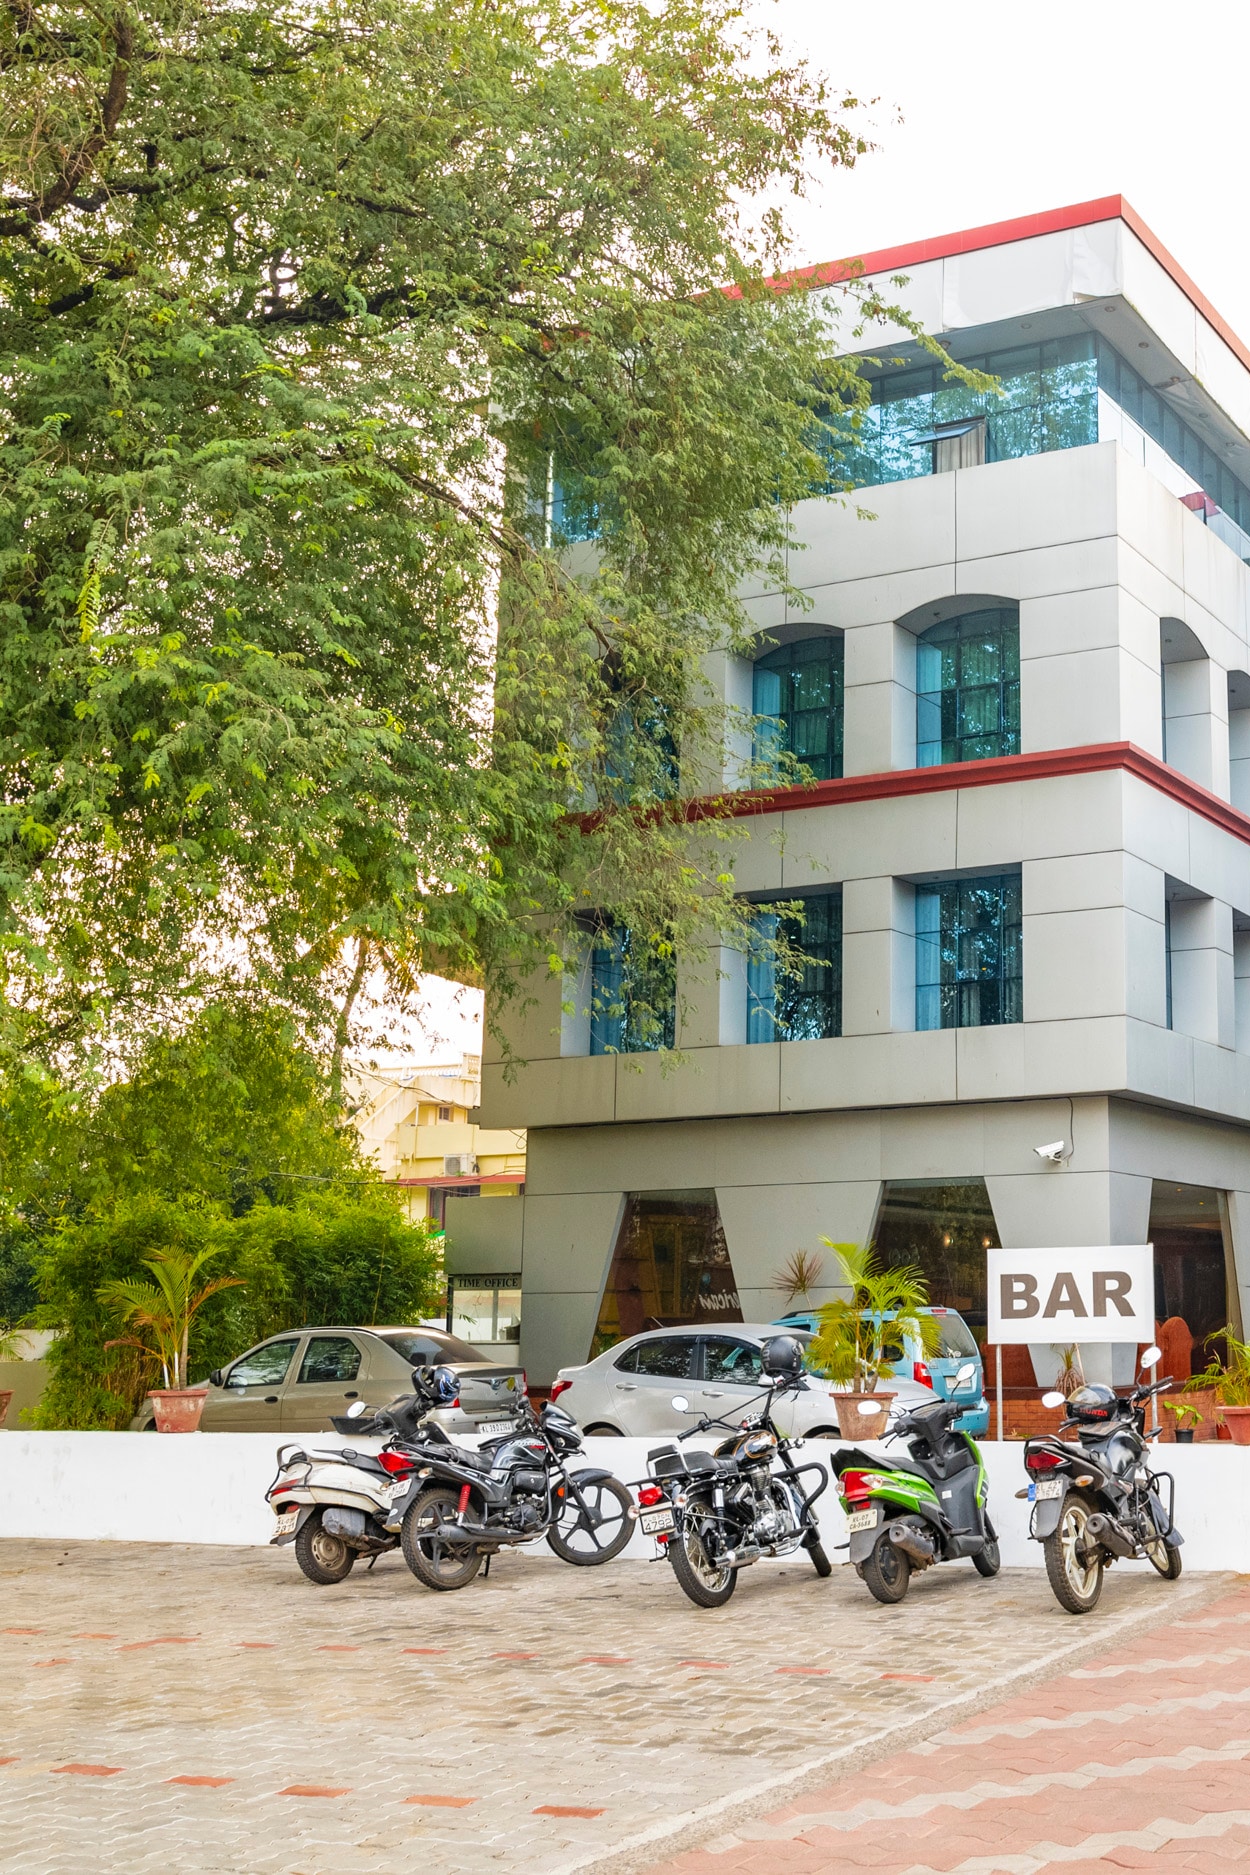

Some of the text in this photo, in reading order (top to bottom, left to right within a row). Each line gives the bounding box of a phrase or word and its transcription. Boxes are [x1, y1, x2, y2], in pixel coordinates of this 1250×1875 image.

[458, 1277, 518, 1288] TIME OFFICE
[1000, 1270, 1136, 1320] BAR
[1079, 1407, 1108, 1417] HONDA
[645, 1517, 673, 1531] 4792
